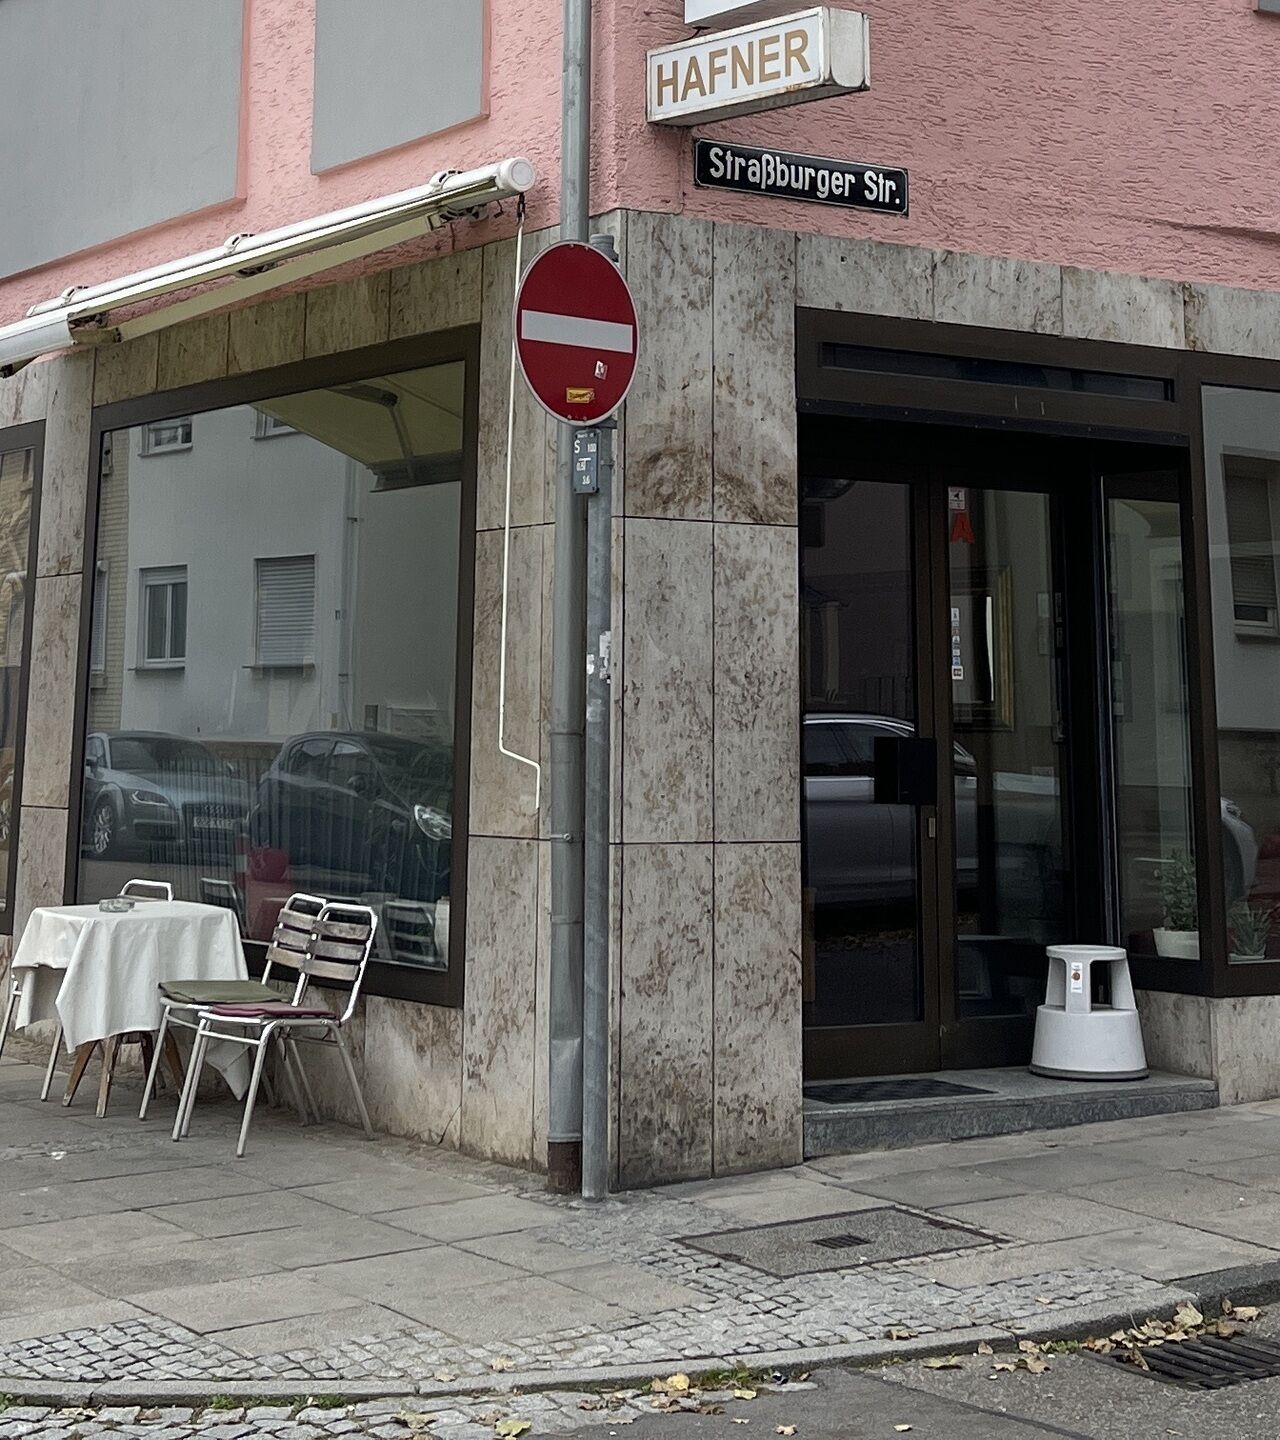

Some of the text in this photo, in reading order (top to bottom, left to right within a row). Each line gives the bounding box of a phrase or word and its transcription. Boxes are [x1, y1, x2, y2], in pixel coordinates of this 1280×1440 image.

[656, 28, 811, 107] HAFNER
[709, 147, 900, 204] Straßburger Str.
